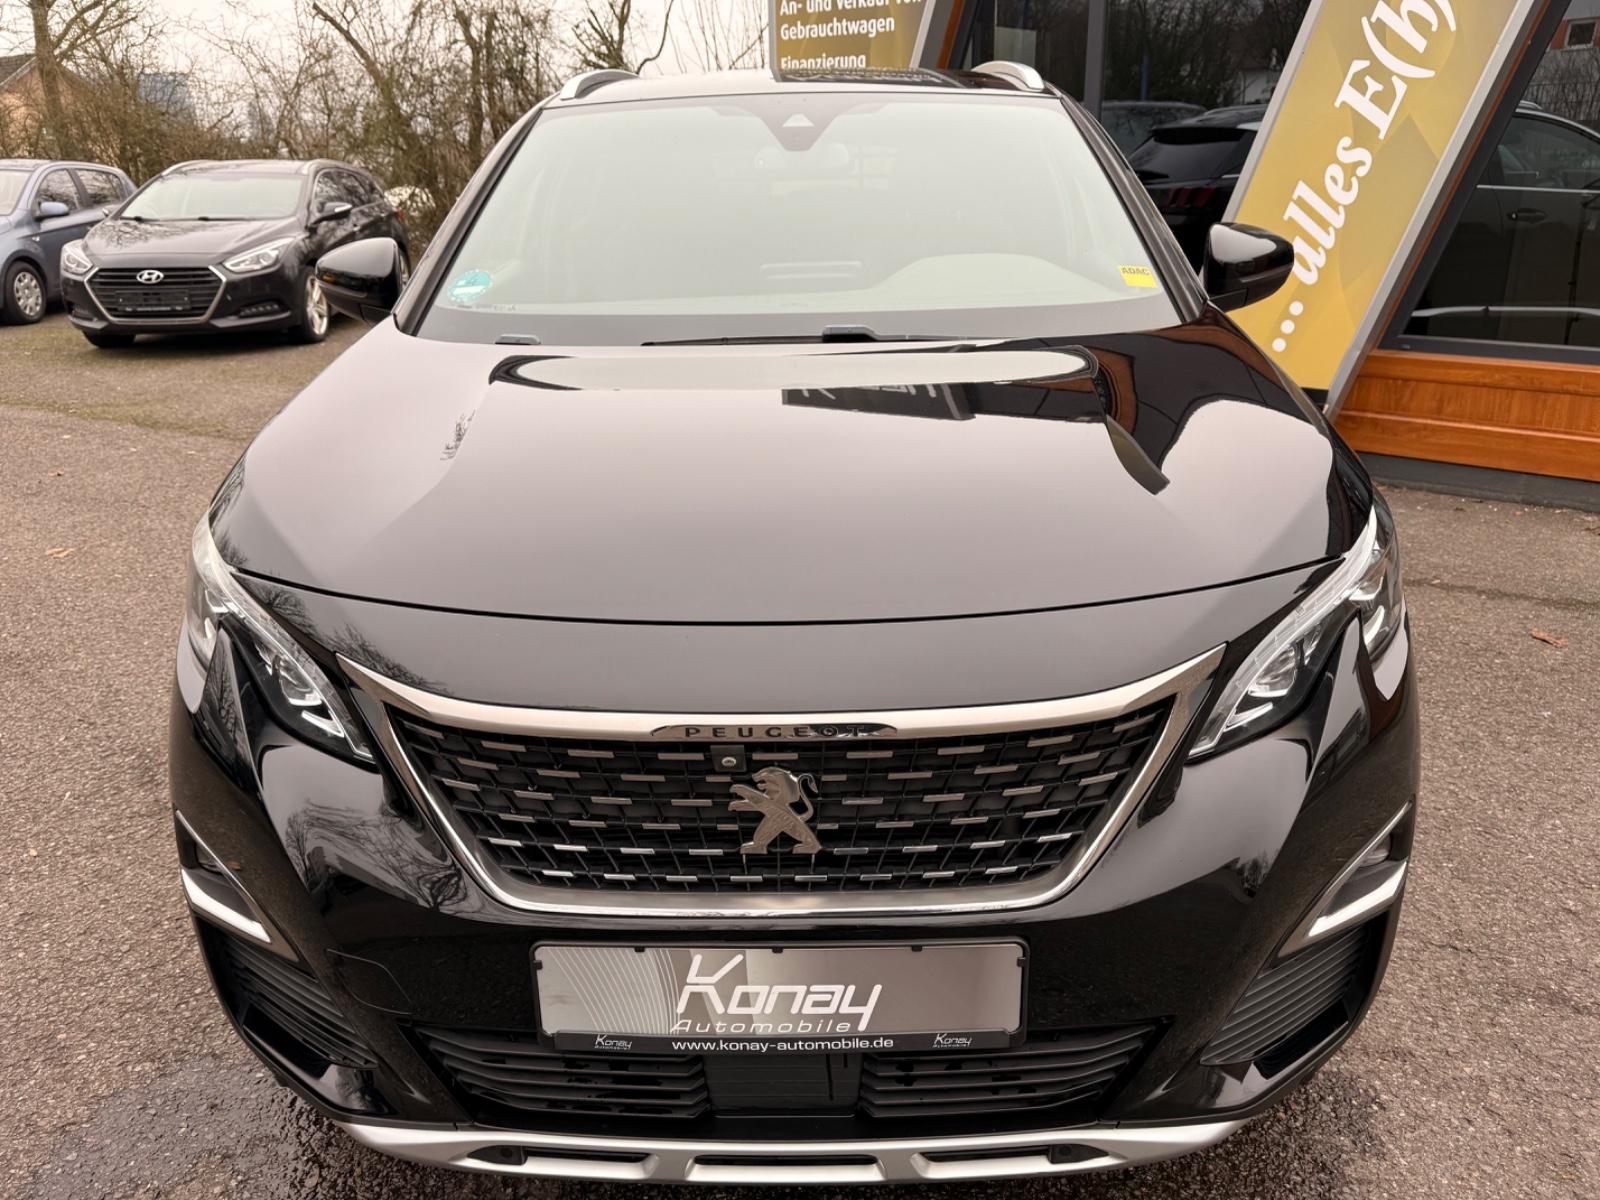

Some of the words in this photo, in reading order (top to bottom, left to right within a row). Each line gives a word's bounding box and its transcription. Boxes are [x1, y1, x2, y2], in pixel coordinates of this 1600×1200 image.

[780, 0, 802, 16] An-
[806, 0, 832, 13] und
[780, 17, 895, 41] Gebrauchtwagen
[1283, 136, 1373, 286] alles
[685, 726, 866, 739] PEUGEOT
[676, 953, 883, 1032] Konay
[670, 1019, 851, 1033] Automobile
[671, 1037, 894, 1053] www.konay-automobile.de
